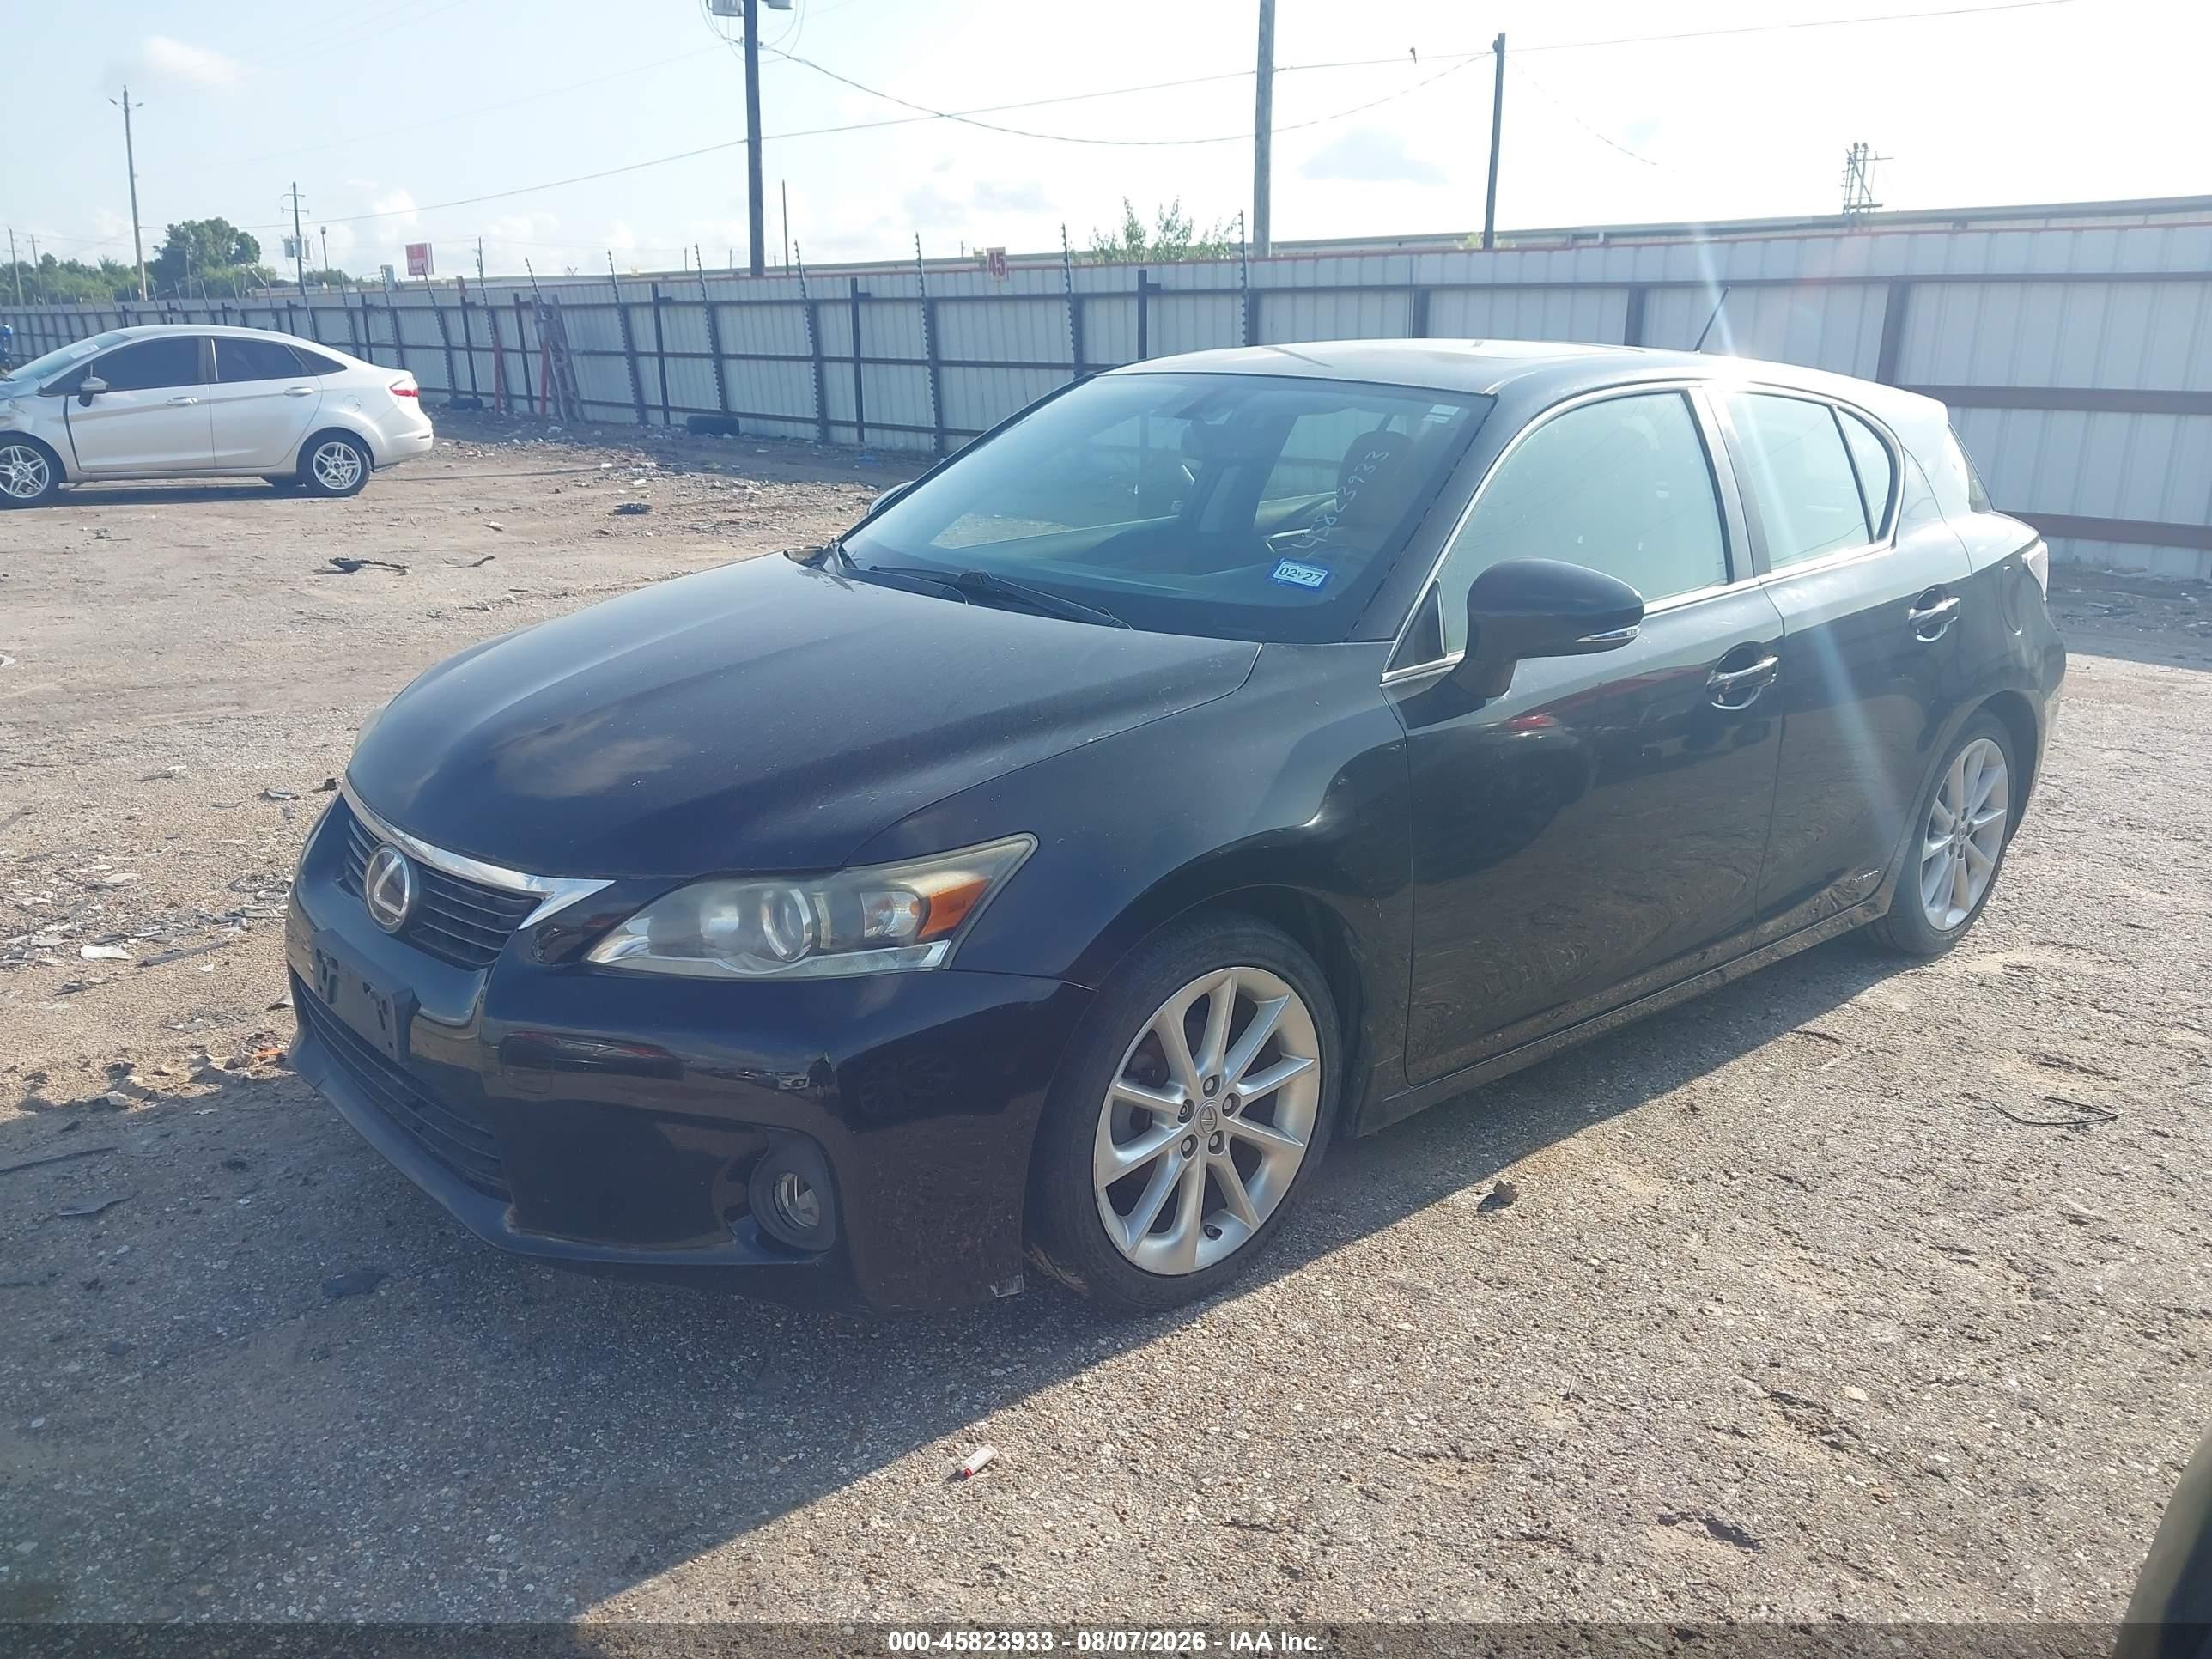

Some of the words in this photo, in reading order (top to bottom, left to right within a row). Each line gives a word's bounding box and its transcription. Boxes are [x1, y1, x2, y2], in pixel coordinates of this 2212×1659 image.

[988, 252, 1006, 276] 45
[1291, 451, 1390, 550] 45823933
[1279, 567, 1298, 578] 02
[1302, 572, 1322, 583] 27
